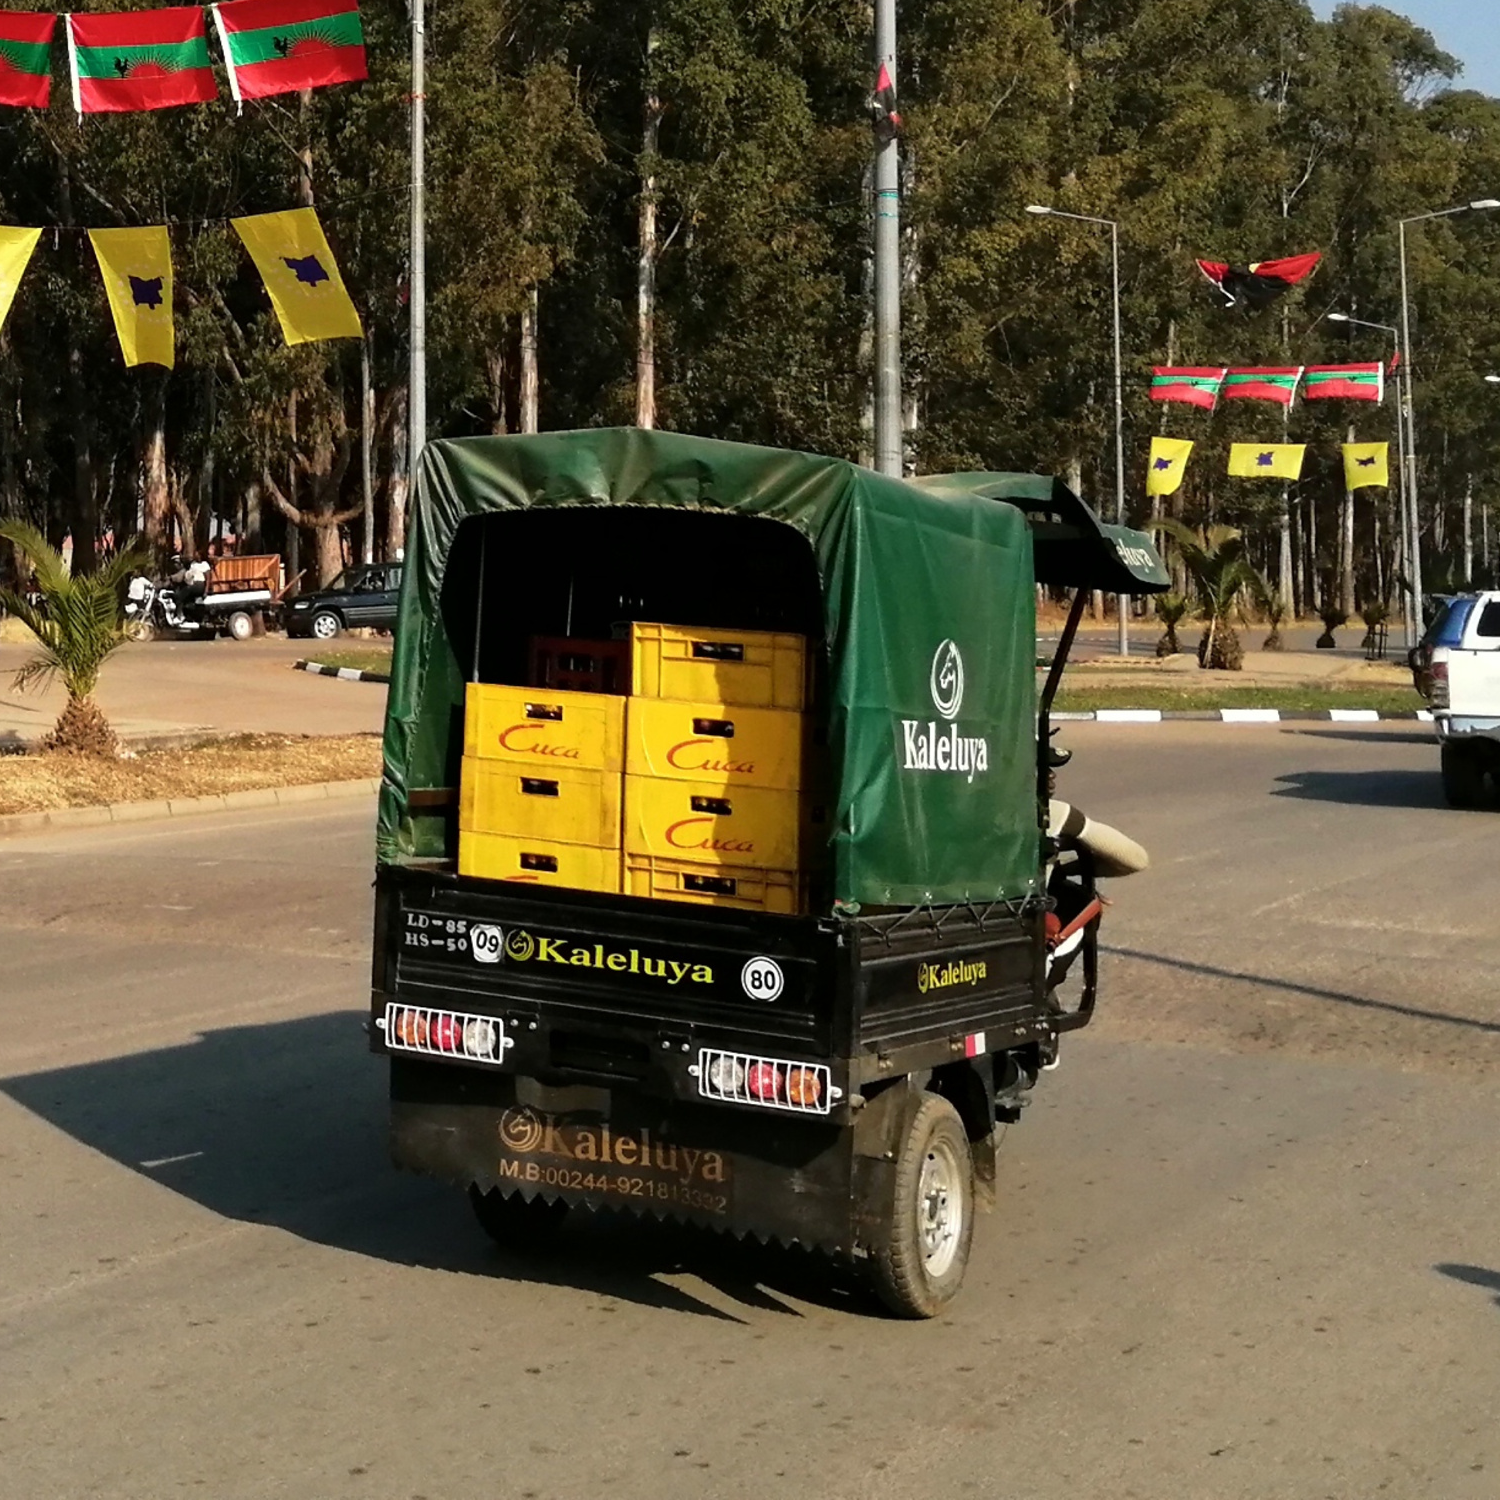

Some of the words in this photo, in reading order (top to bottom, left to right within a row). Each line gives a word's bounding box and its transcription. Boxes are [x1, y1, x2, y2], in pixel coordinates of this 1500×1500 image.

[498, 723, 580, 759] Cuca
[666, 738, 755, 774] Cuca
[901, 720, 988, 784] Kaleluya
[665, 817, 755, 853] Cuca
[476, 930, 500, 953] 09
[536, 936, 714, 984] Kaleluya
[929, 960, 987, 986] Kaleluya
[750, 969, 776, 990] 80
[541, 1113, 726, 1185] Kaleluya
